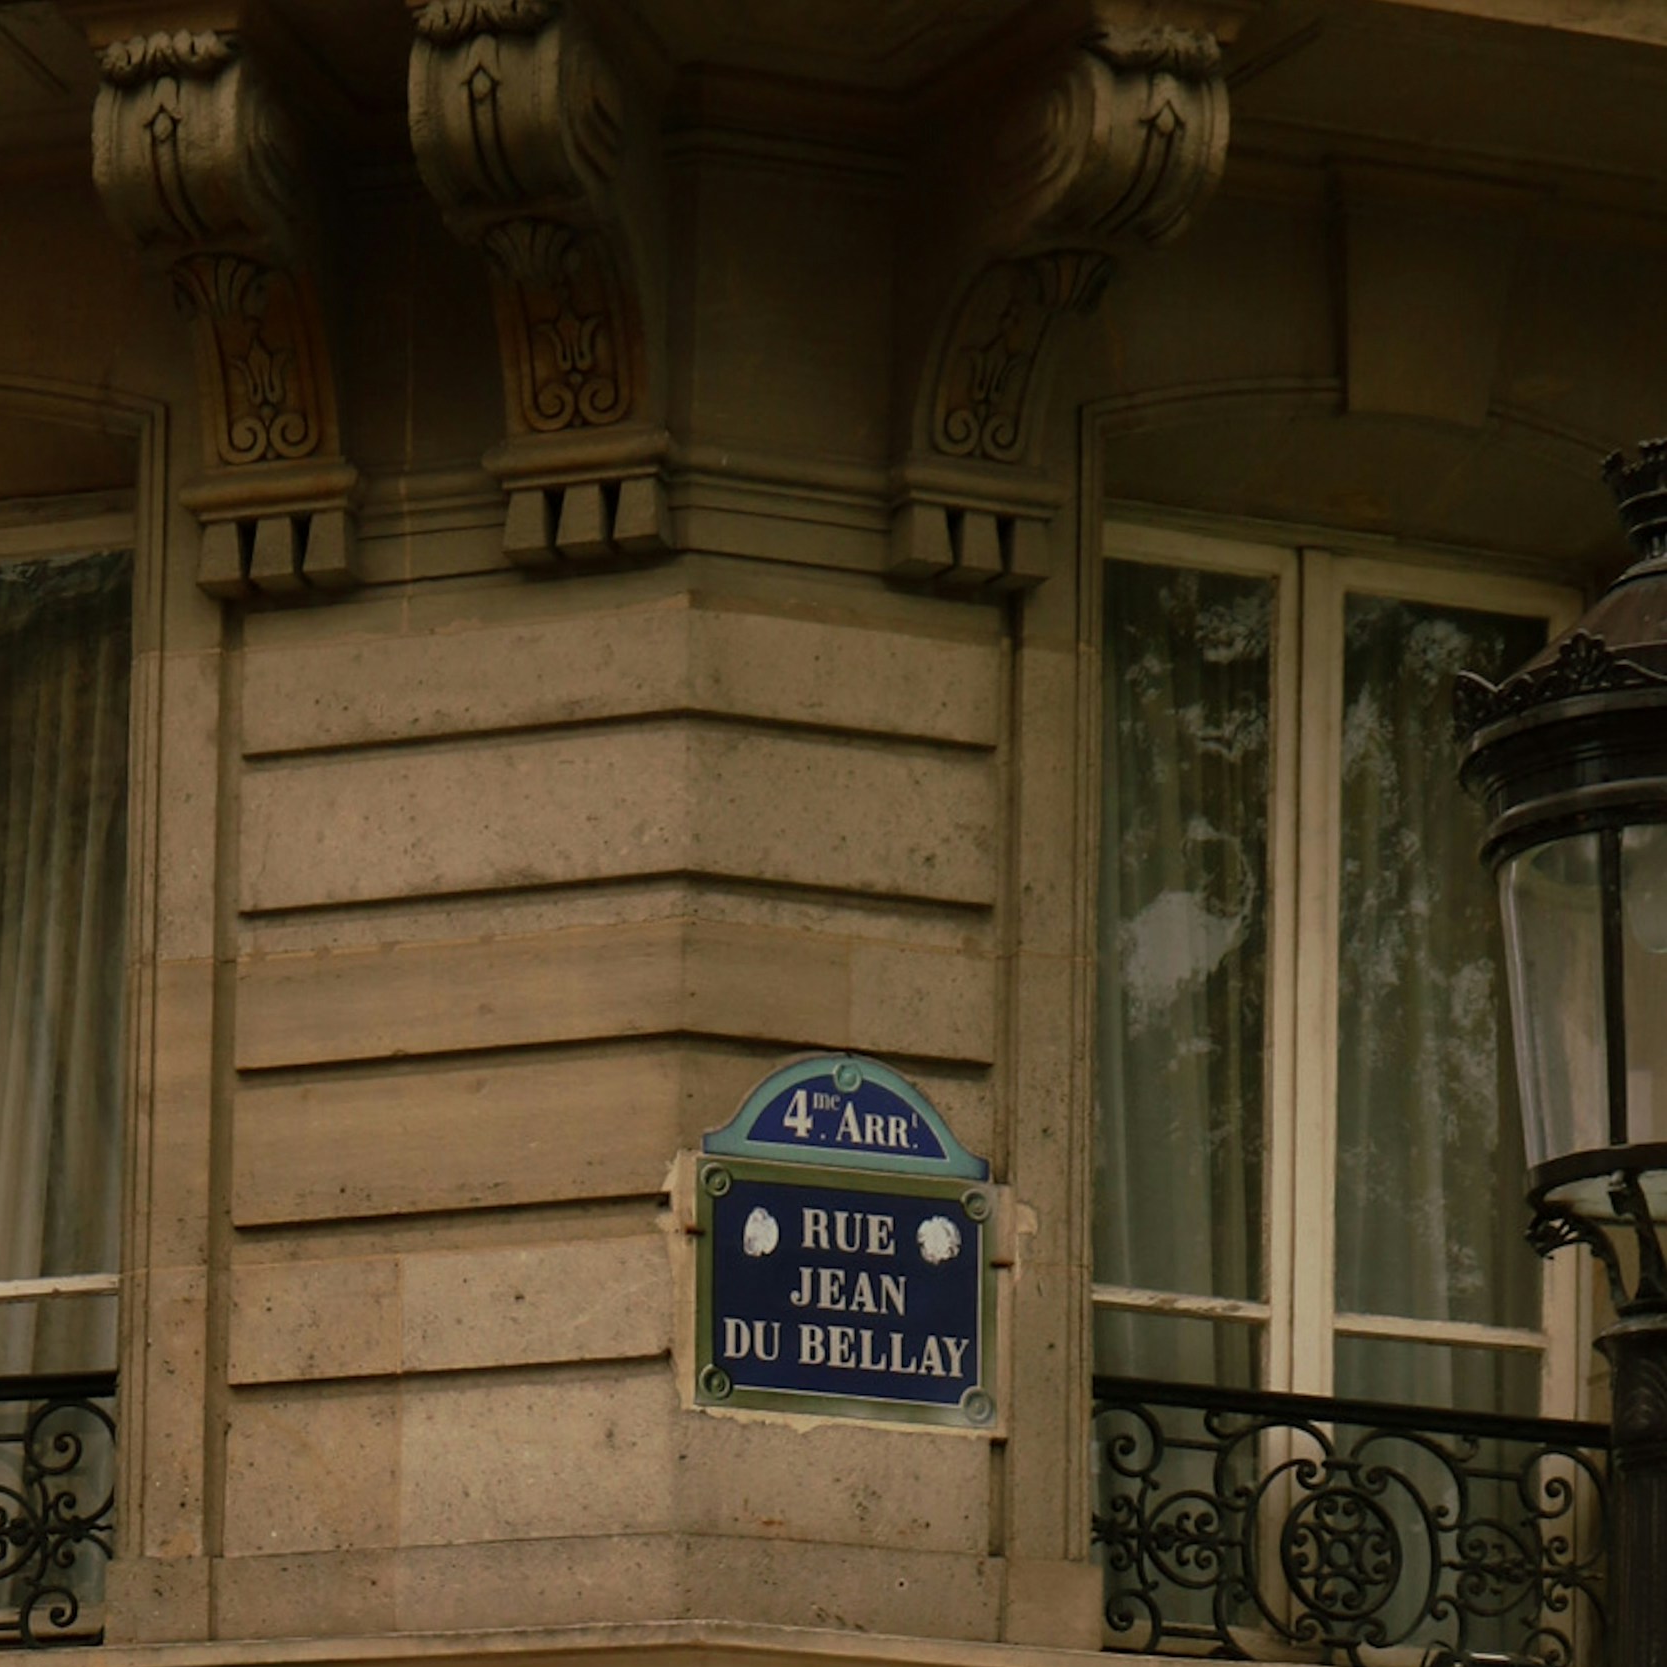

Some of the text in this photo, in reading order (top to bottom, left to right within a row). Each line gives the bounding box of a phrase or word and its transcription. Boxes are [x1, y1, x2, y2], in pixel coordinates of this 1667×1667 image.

[801, 1207, 895, 1256] RUE
[790, 1267, 907, 1316] JEAN
[723, 1318, 969, 1378] DU BELLAY
